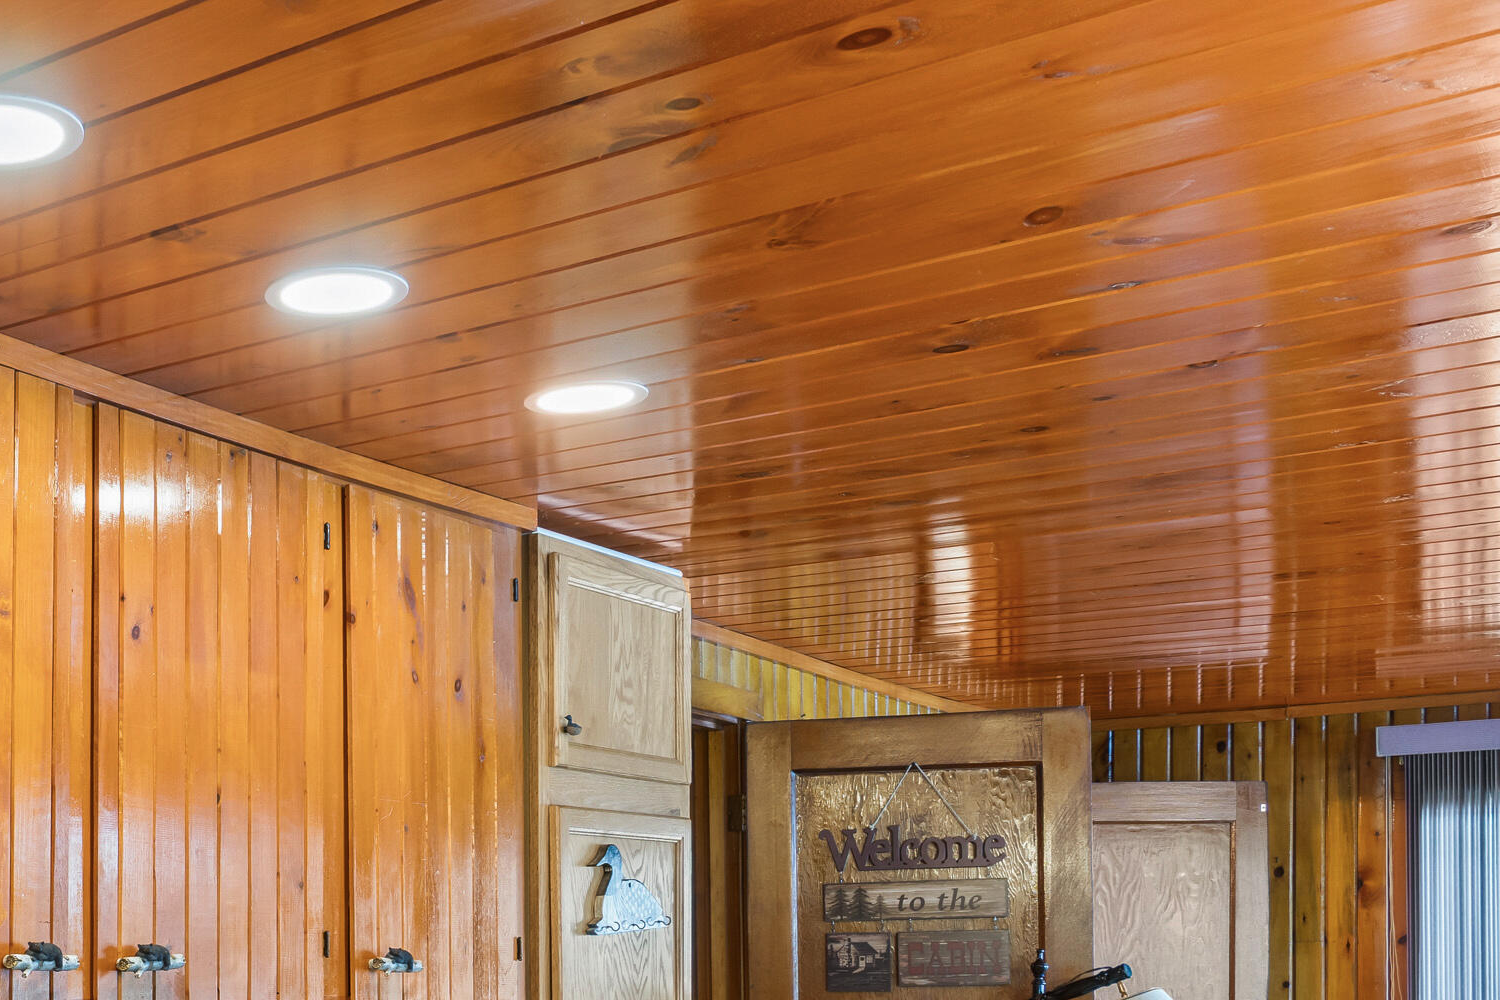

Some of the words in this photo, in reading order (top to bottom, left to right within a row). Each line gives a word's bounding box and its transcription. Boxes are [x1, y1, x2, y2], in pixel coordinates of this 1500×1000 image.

[818, 825, 1007, 872] Welcome
[897, 894, 925, 912] to
[937, 888, 982, 911] the
[908, 940, 1001, 975] CABIN
